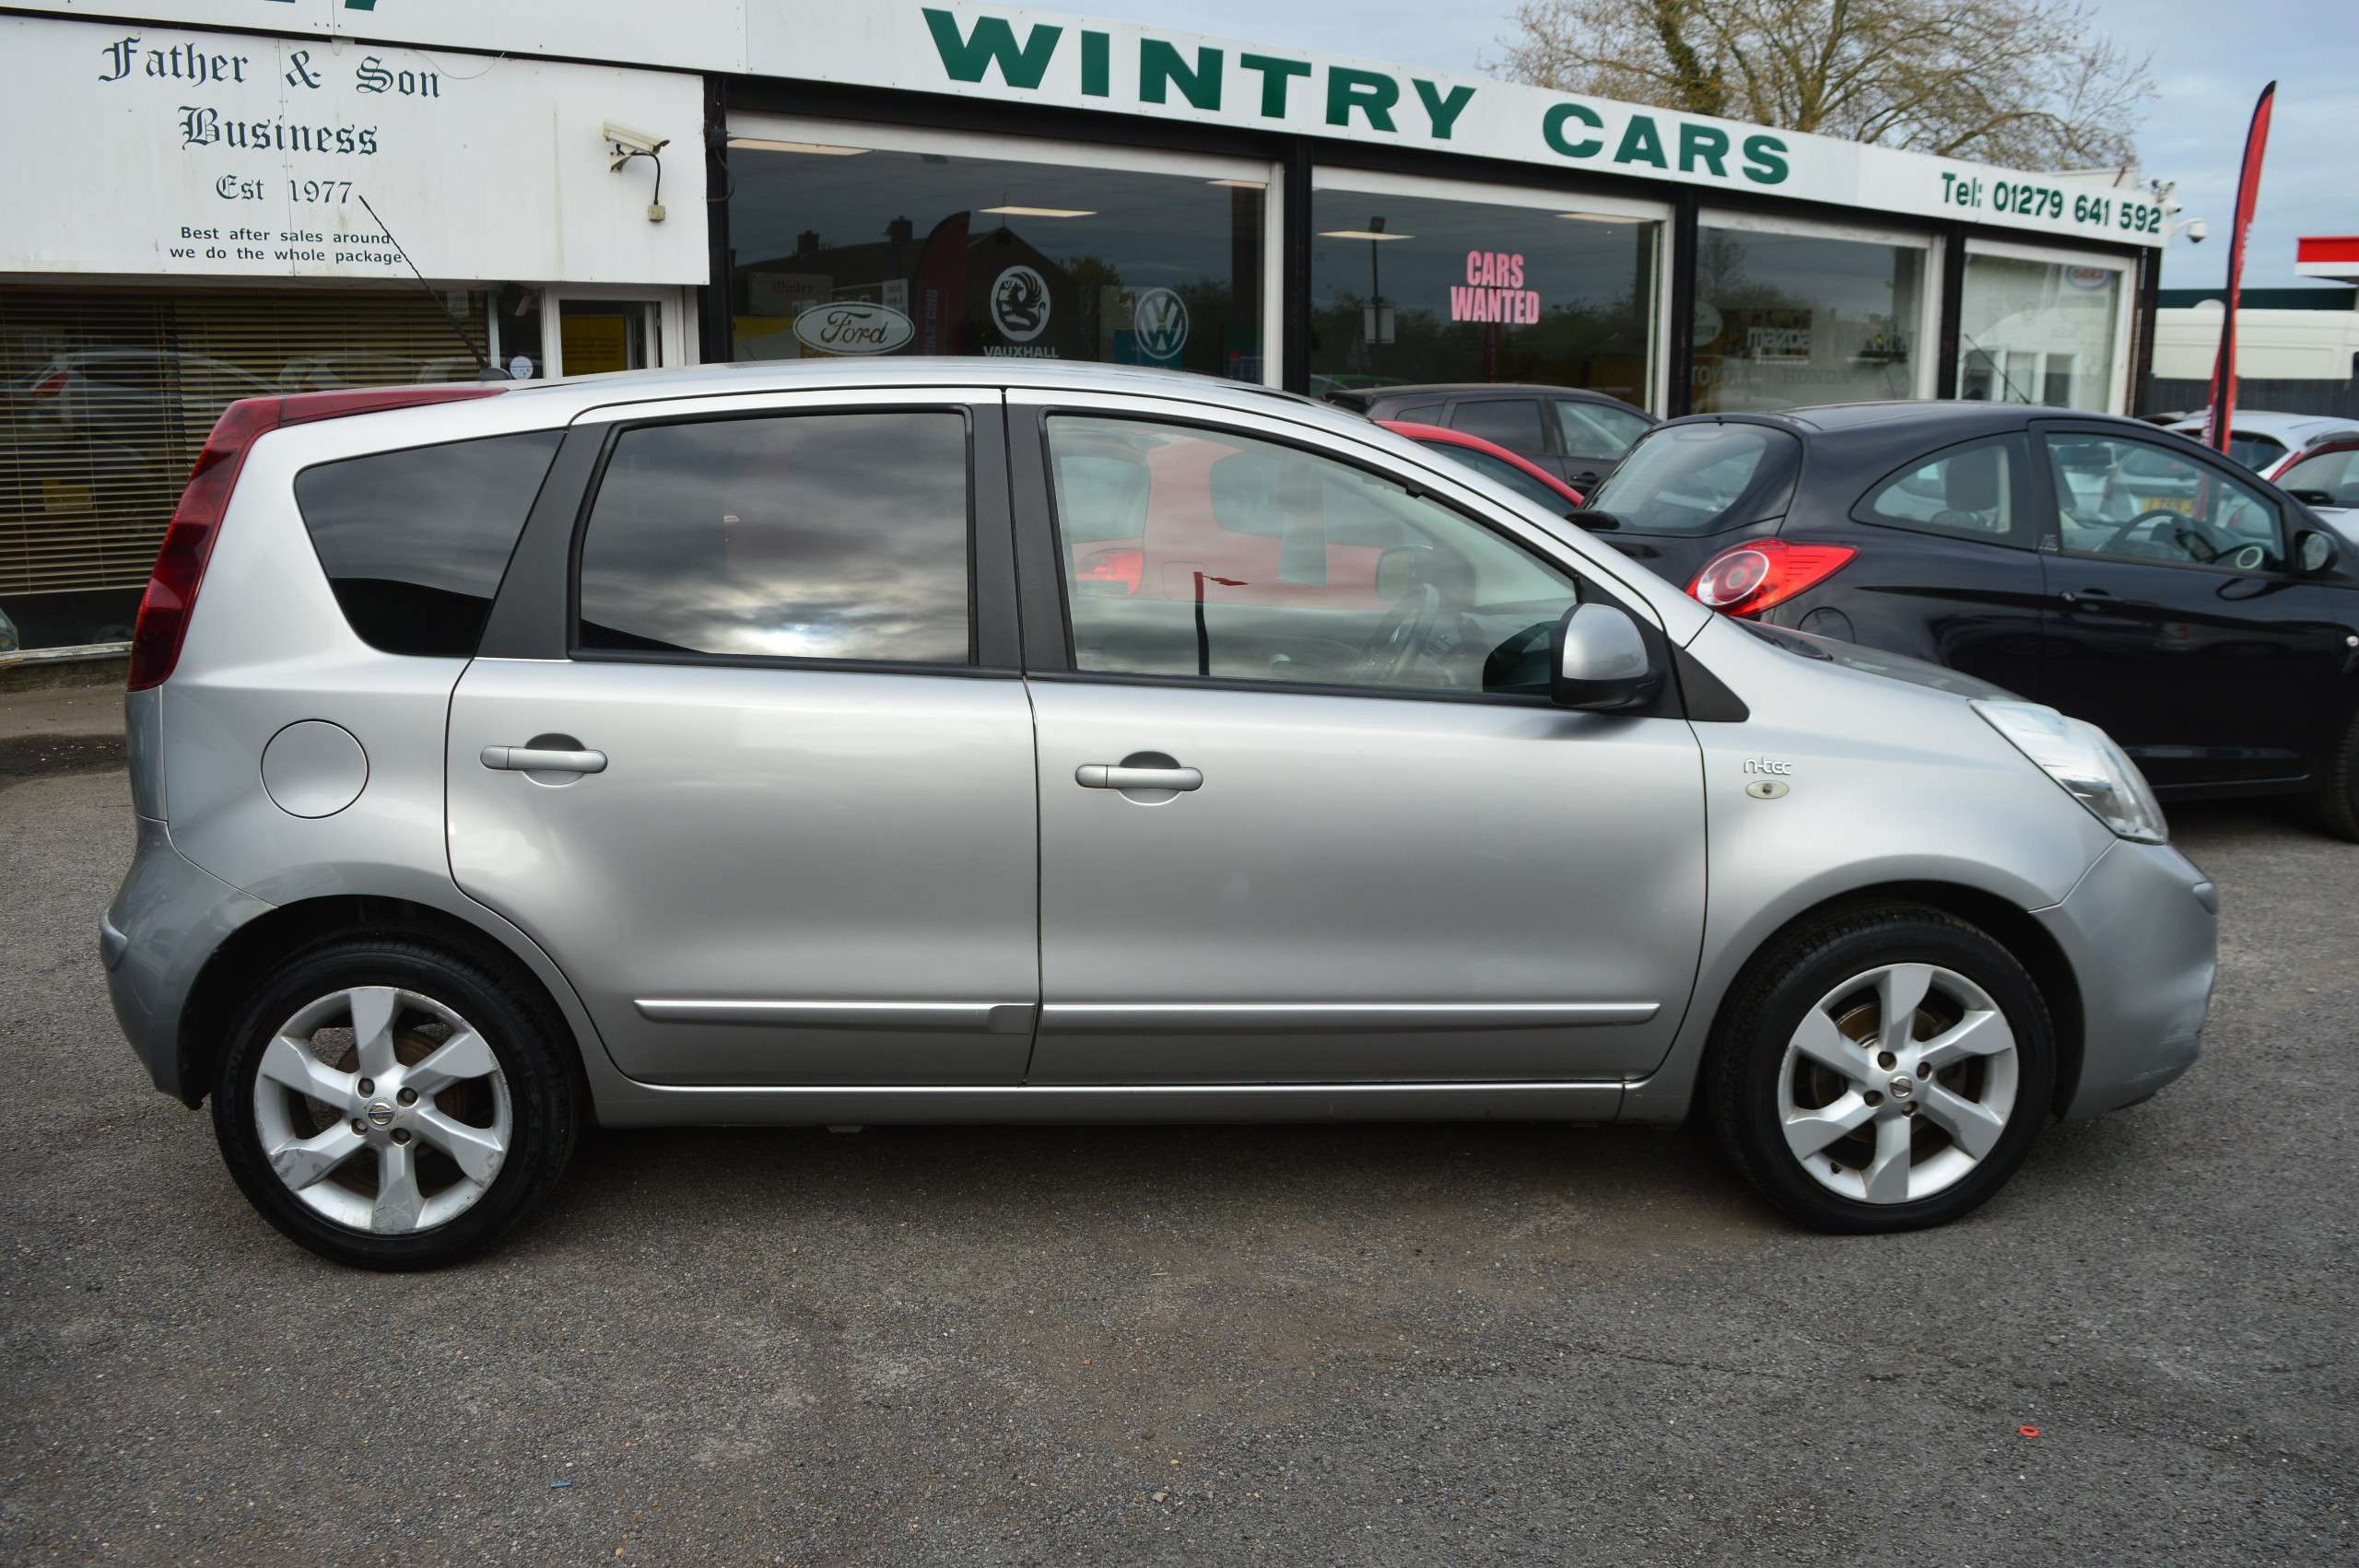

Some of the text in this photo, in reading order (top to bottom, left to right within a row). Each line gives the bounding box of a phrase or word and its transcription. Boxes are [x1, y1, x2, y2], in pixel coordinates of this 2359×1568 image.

[98, 37, 441, 99] Father & Son
[921, 7, 1789, 185] WINTRY CARS
[178, 105, 379, 156] Business
[216, 174, 353, 204] Est 1977
[1942, 171, 2163, 234] Tel: 01279 641 592
[181, 227, 391, 244] Best after sales around
[170, 246, 403, 265] we do the whole package
[1466, 250, 1524, 289] CARS
[1450, 286, 1540, 324] WANTED
[820, 310, 888, 344] Ford
[982, 345, 1059, 358] VAUXHALL
